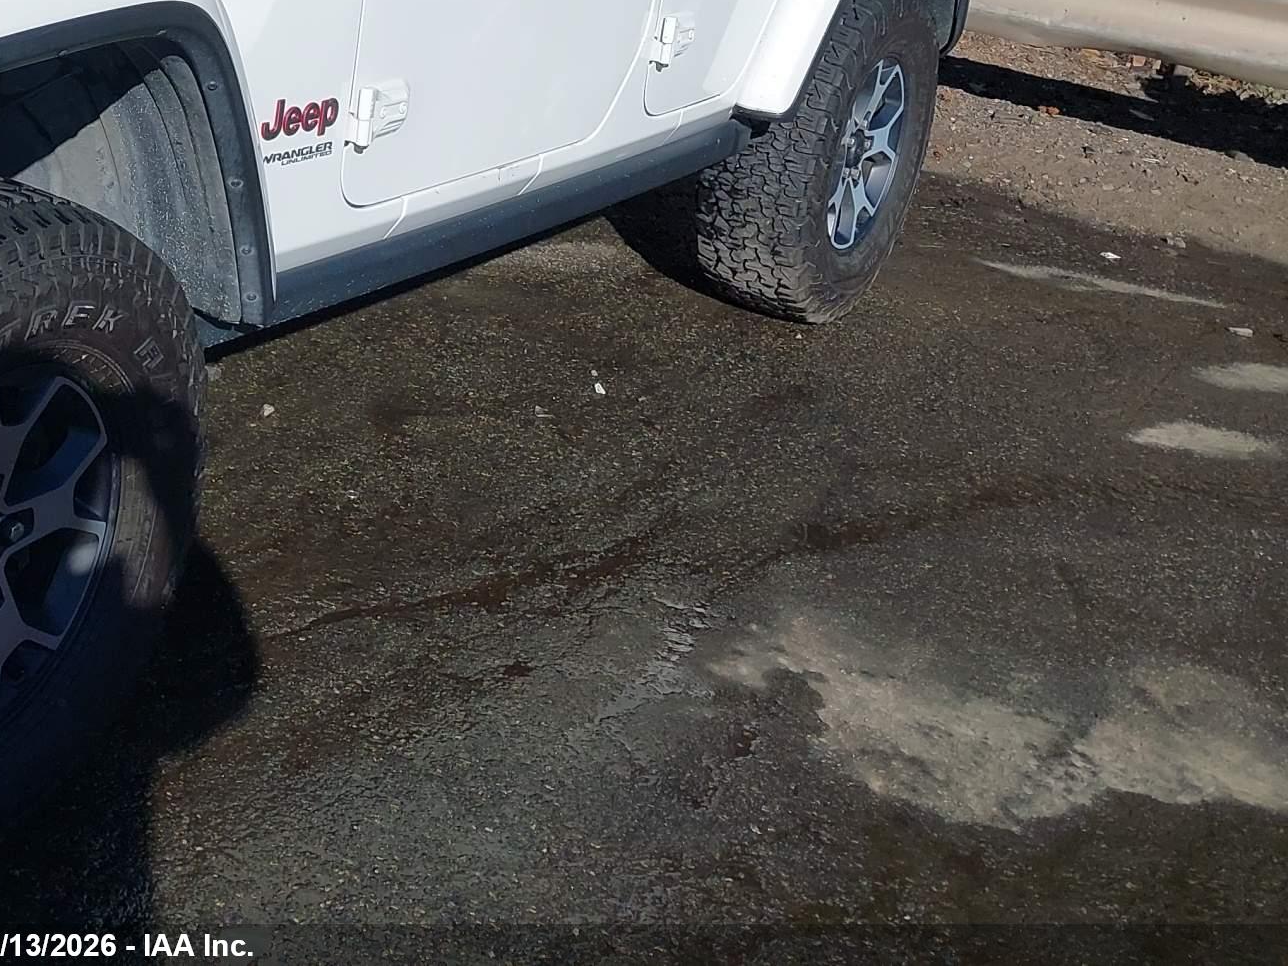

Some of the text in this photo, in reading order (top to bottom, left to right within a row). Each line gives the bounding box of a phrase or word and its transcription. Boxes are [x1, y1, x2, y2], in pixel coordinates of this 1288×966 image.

[260, 97, 339, 141] Jeep
[262, 141, 333, 164] WRANGLER
[281, 150, 332, 166] UNLIMITED
